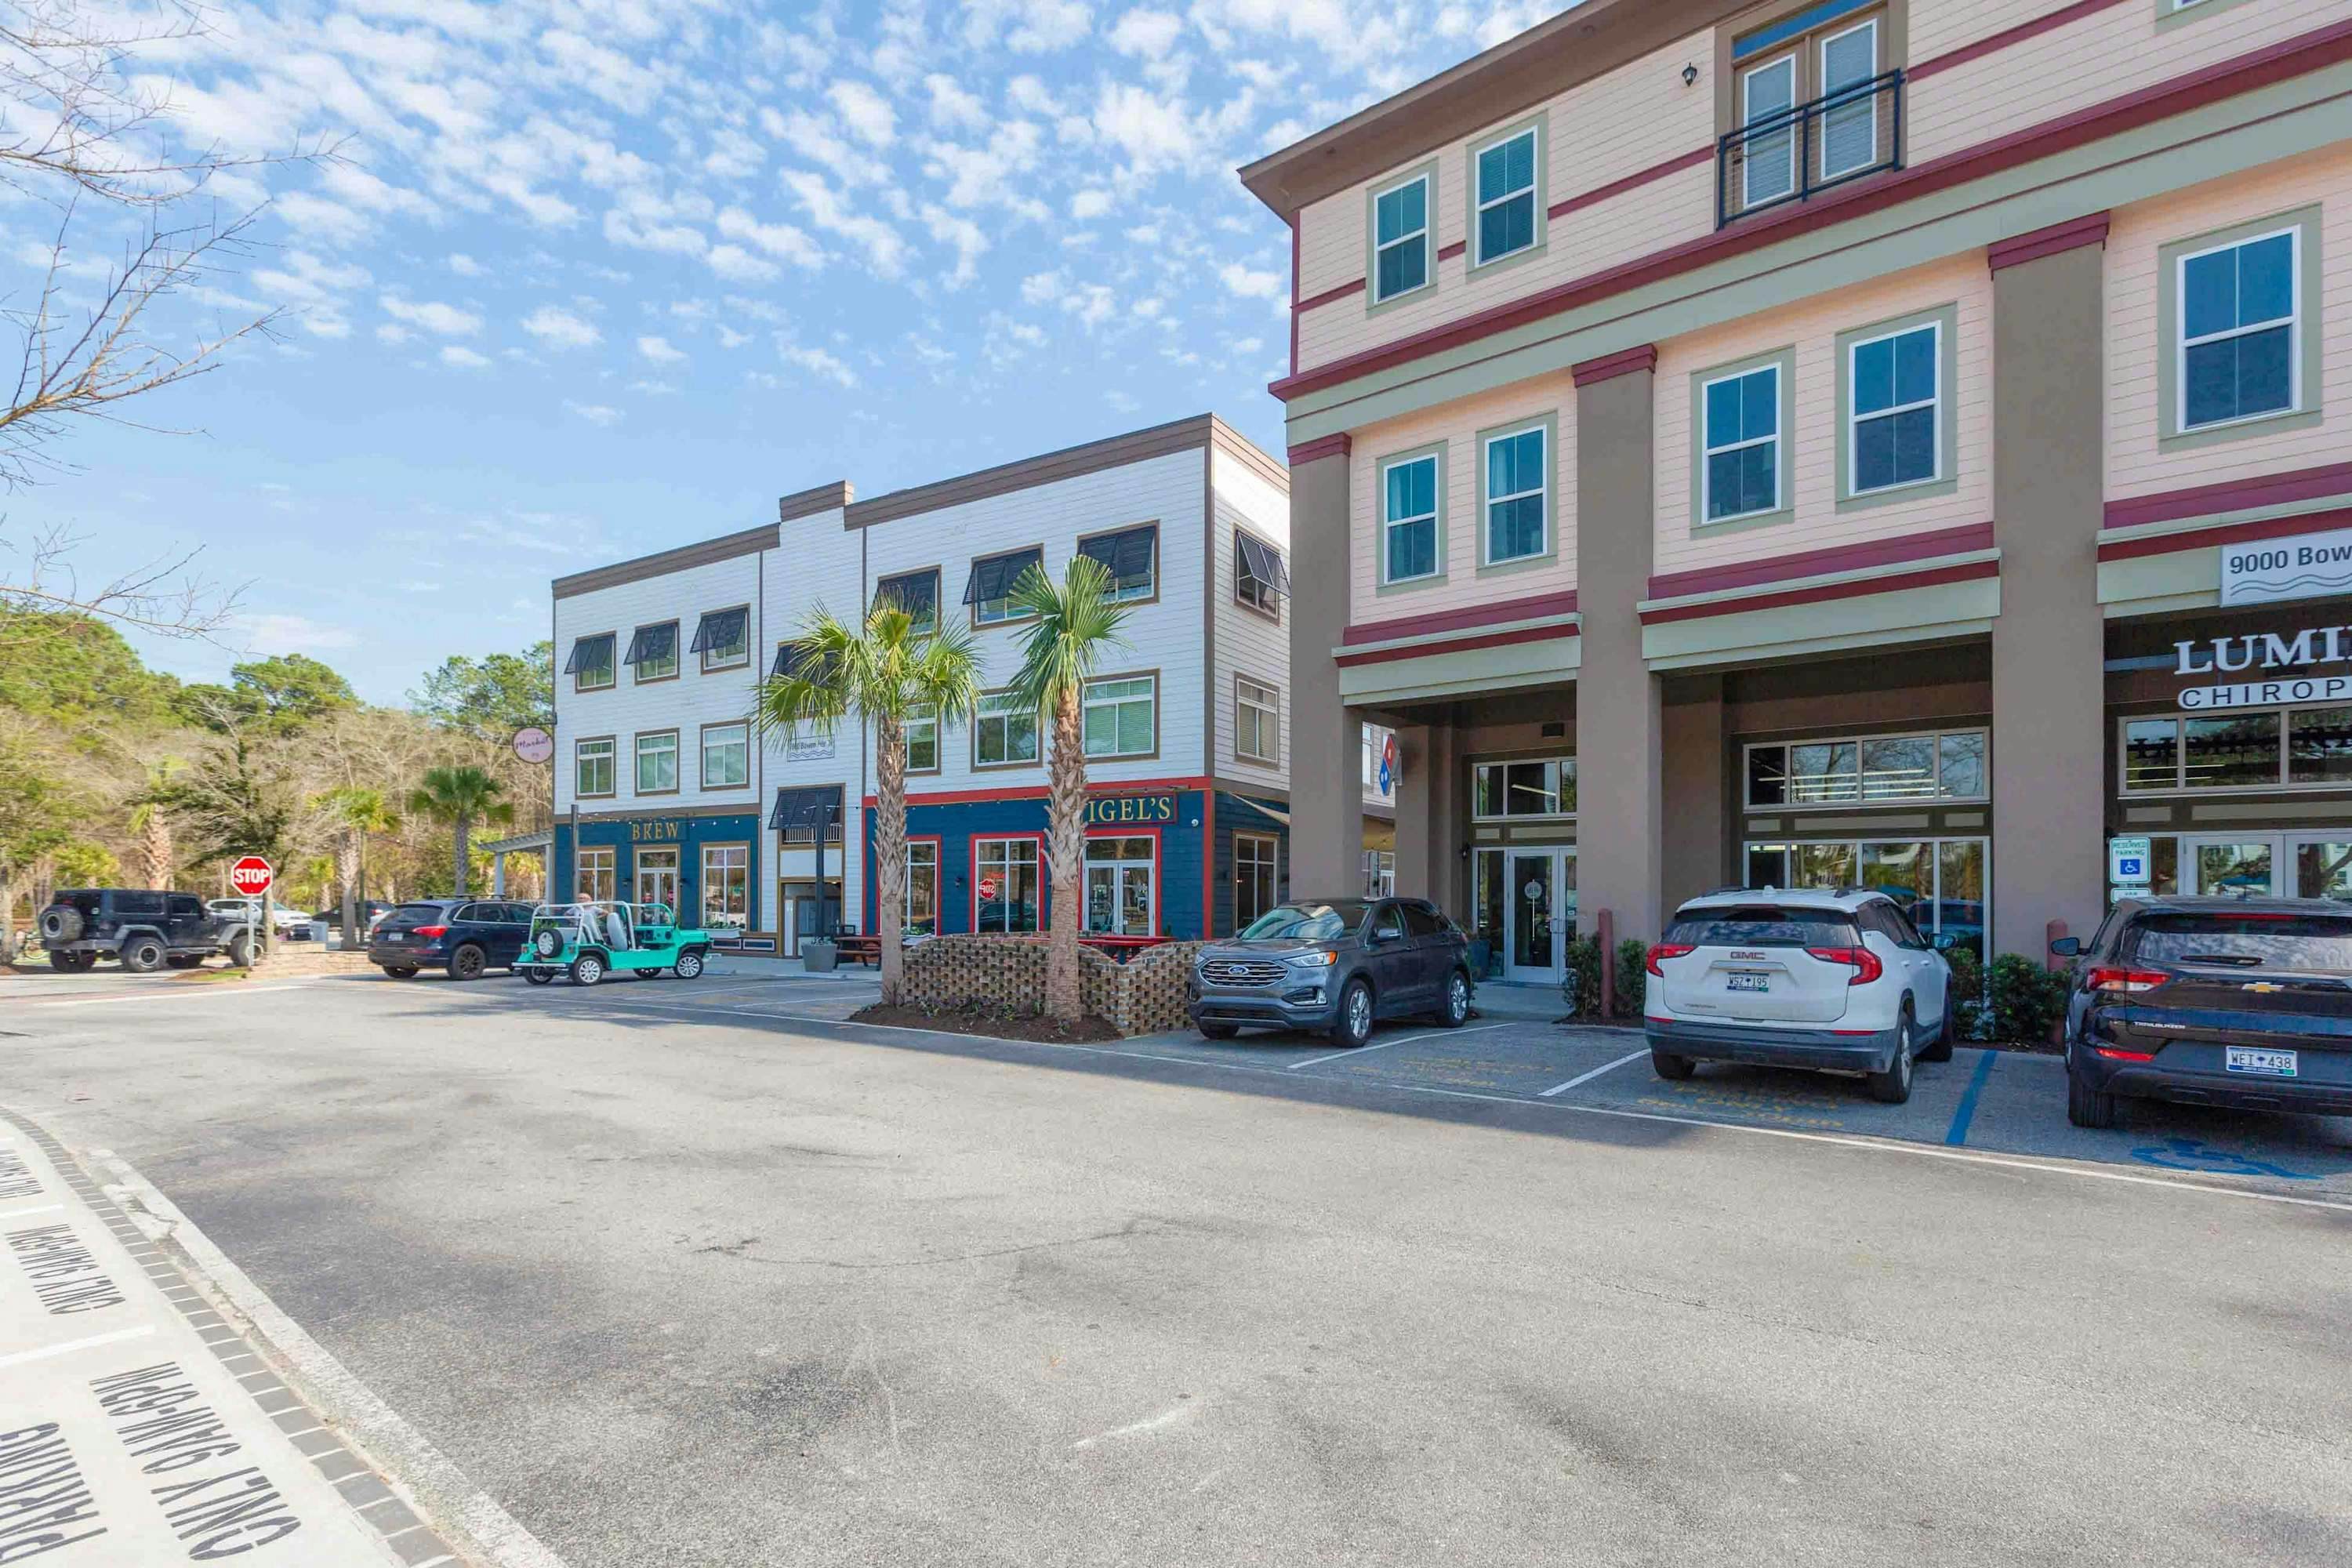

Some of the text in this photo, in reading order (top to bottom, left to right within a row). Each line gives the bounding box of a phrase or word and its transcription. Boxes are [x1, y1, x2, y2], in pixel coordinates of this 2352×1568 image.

[2230, 550, 2288, 574] 9000
[2173, 626, 2352, 675] LUMI
[2183, 679, 2346, 706] CHIROP
[1088, 797, 1171, 822] IGEL'S
[632, 822, 678, 840] BREW
[234, 868, 270, 884] STOP
[1730, 951, 1766, 960] GMC
[2231, 1052, 2292, 1069] WEI 438
[34, 1275, 126, 1315] ONLY
[89, 1361, 301, 1561] ONLY 9AM-6PM
